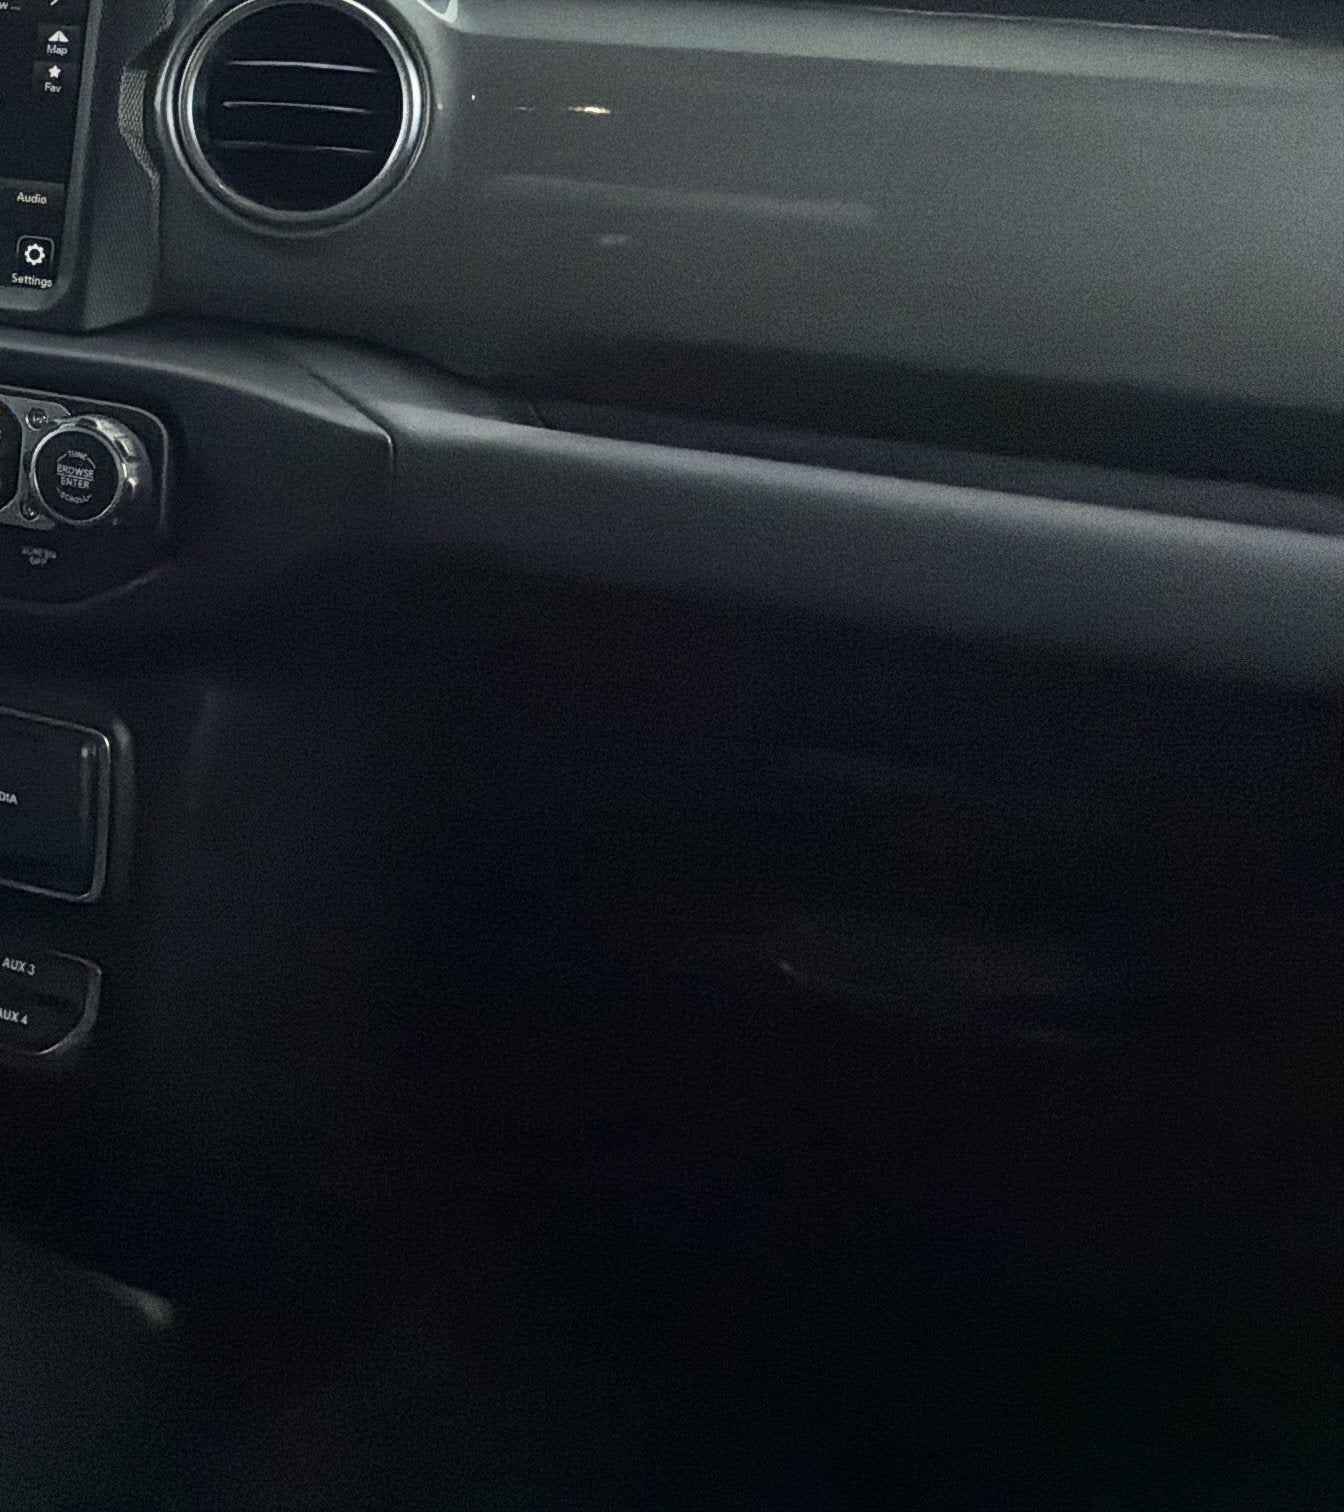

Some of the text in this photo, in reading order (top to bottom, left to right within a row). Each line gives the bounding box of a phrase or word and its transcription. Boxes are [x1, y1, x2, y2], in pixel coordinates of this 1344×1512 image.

[16, 191, 47, 205] Audio
[12, 273, 53, 289] Settings
[56, 463, 94, 478] BROWSE
[60, 477, 90, 490] ENTER
[1, 957, 36, 976] AUX 3
[20, 1014, 29, 1025] 4
